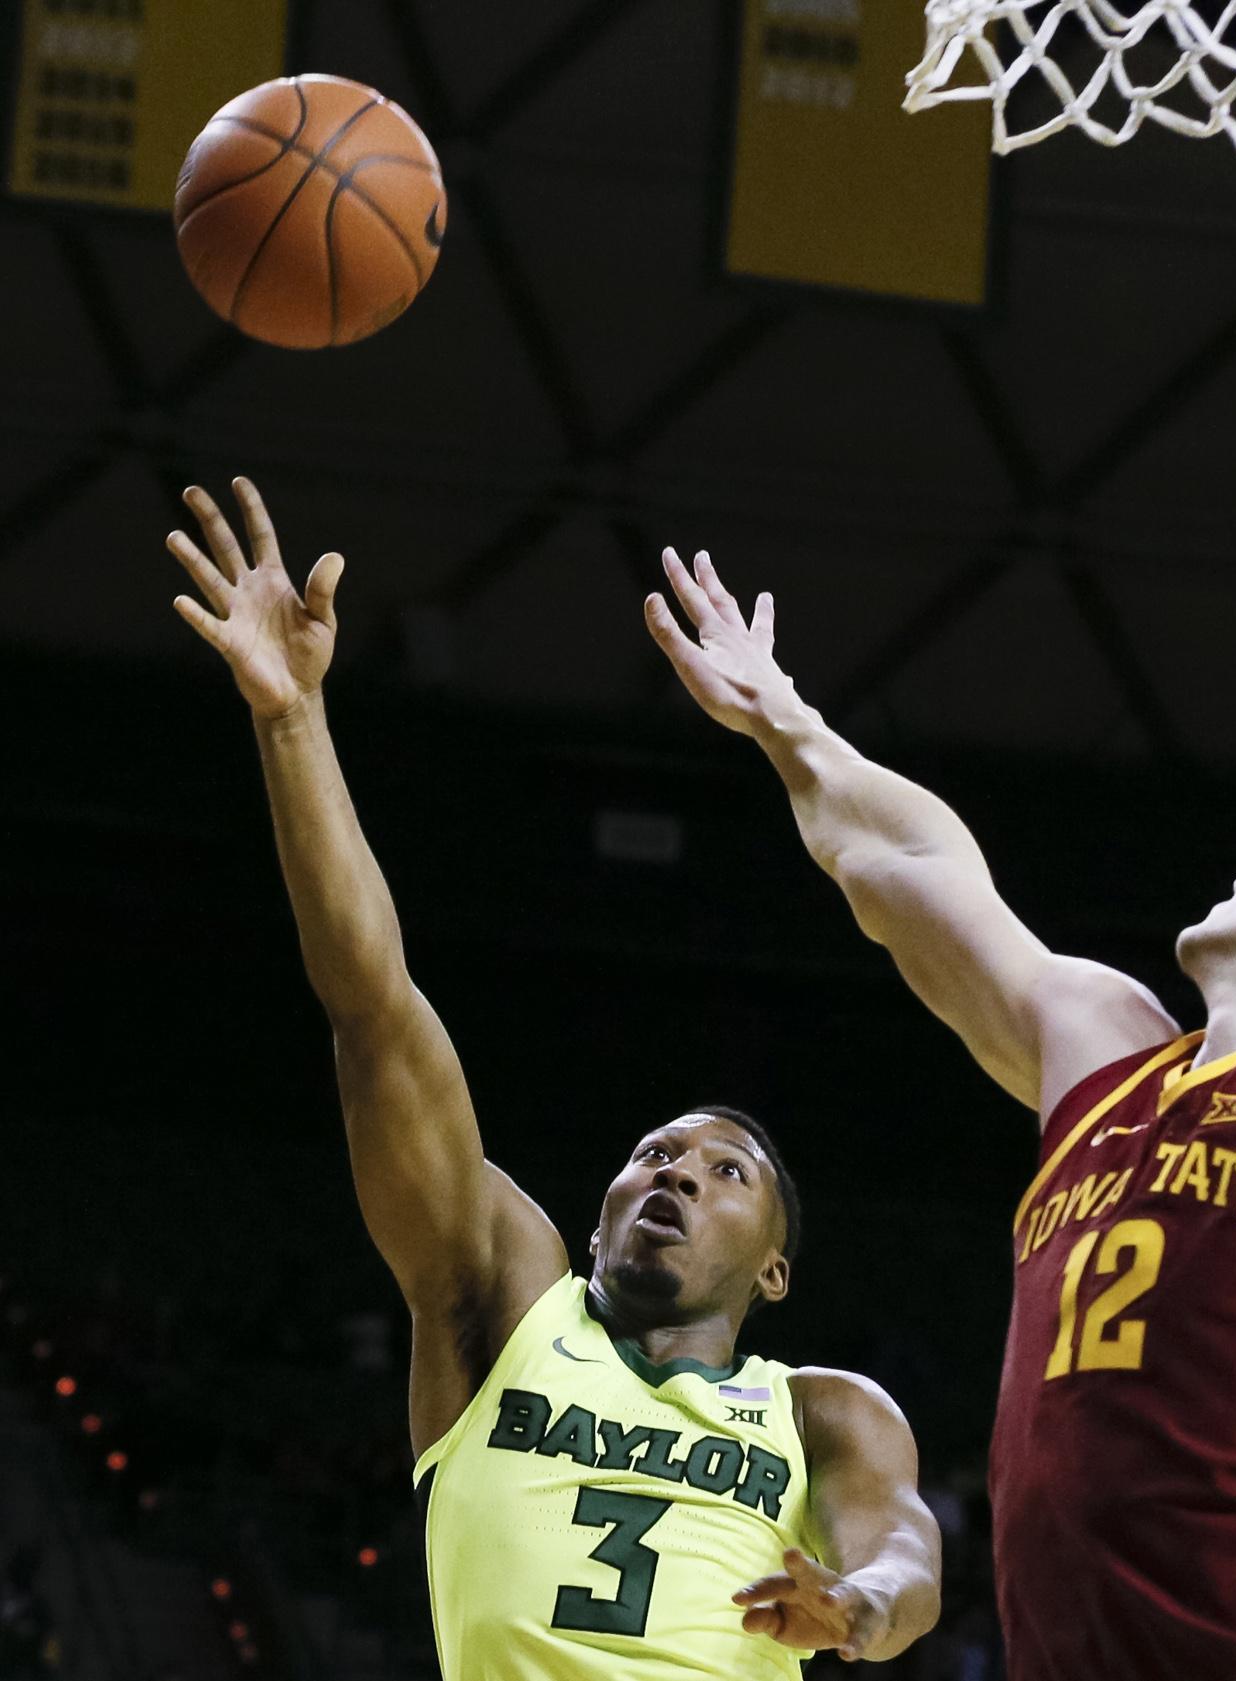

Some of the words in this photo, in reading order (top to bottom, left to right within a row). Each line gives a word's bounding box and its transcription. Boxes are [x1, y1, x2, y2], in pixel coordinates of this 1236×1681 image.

[1043, 1218, 1166, 1381] 12
[487, 1388, 791, 1522] BAYLOR
[724, 1405, 768, 1429] XII
[551, 1485, 673, 1637] 3
